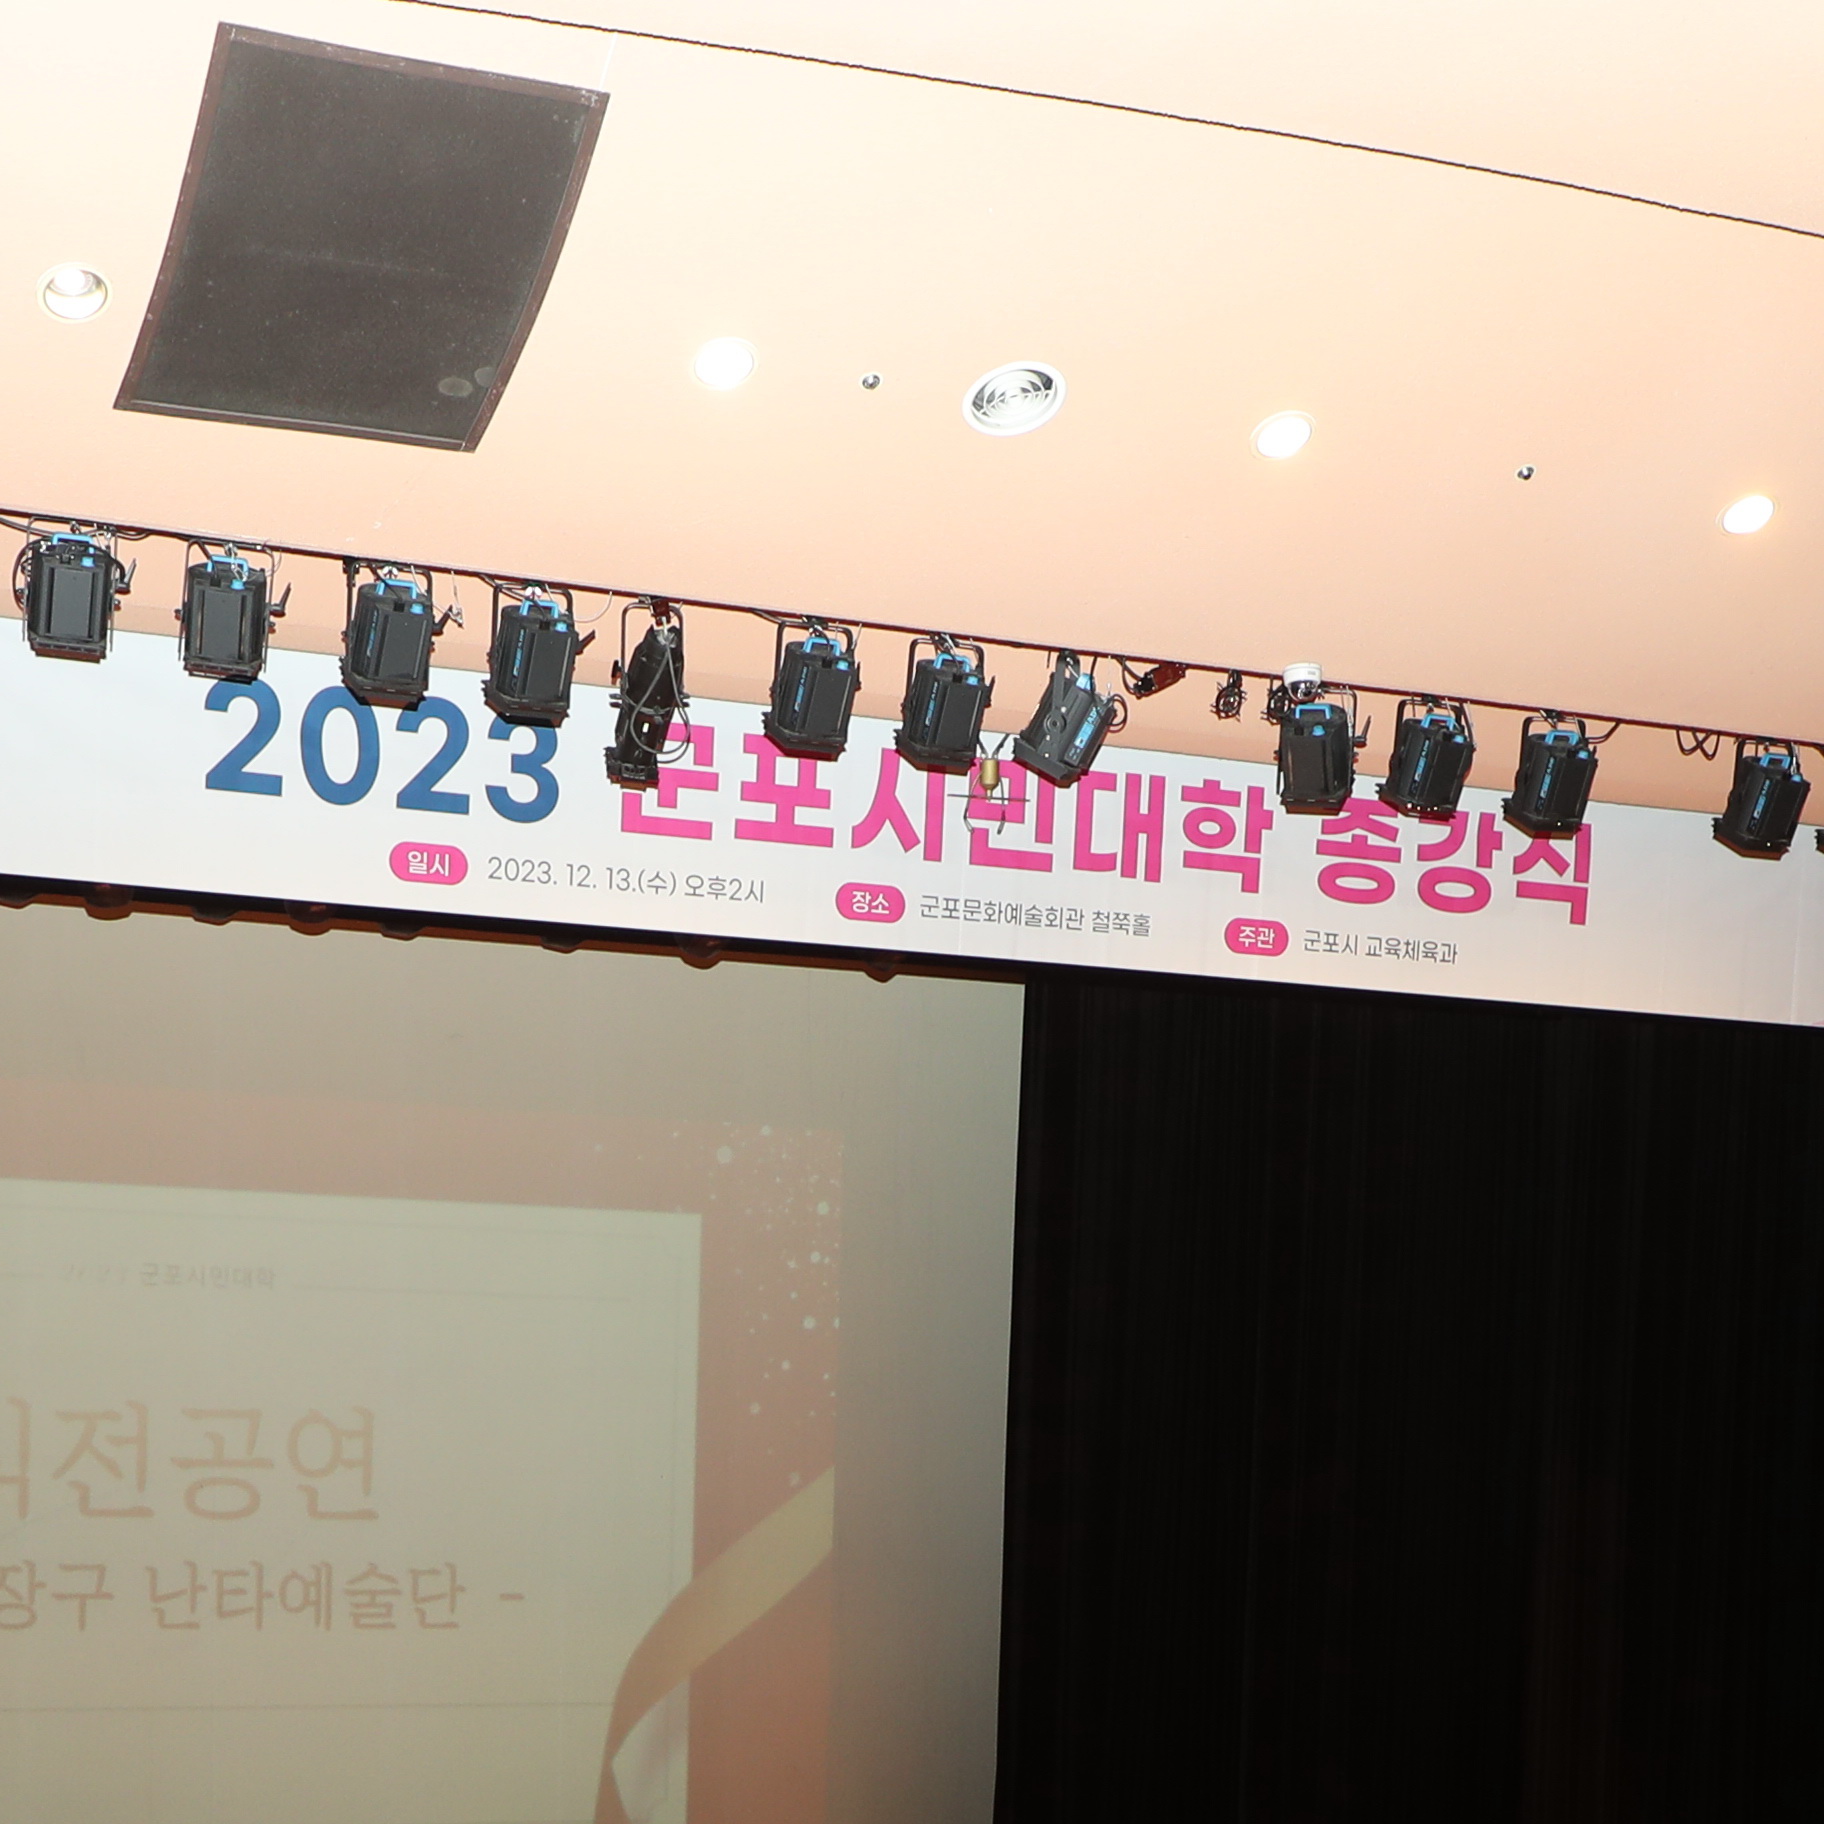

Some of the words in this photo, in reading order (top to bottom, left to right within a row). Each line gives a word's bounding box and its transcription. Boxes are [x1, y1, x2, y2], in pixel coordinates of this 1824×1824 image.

[204, 678, 560, 824] 2023
[621, 722, 1273, 894] 군포시민대학
[1316, 797, 1592, 926] 종강식
[407, 851, 450, 877] 일시
[487, 856, 557, 885] 2023.
[567, 863, 597, 890] 12.
[606, 867, 677, 897] 13.(수)
[683, 873, 765, 904] 오후2시
[851, 890, 890, 916] 장소
[919, 894, 1085, 932] 군포문화예술회관
[1092, 909, 1151, 938] 철쭉홀
[1238, 925, 1276, 950] 주관
[1303, 929, 1359, 956] 군포시
[1365, 935, 1458, 965] 교육체육과
[144, 1560, 467, 1632] 난타예술단
